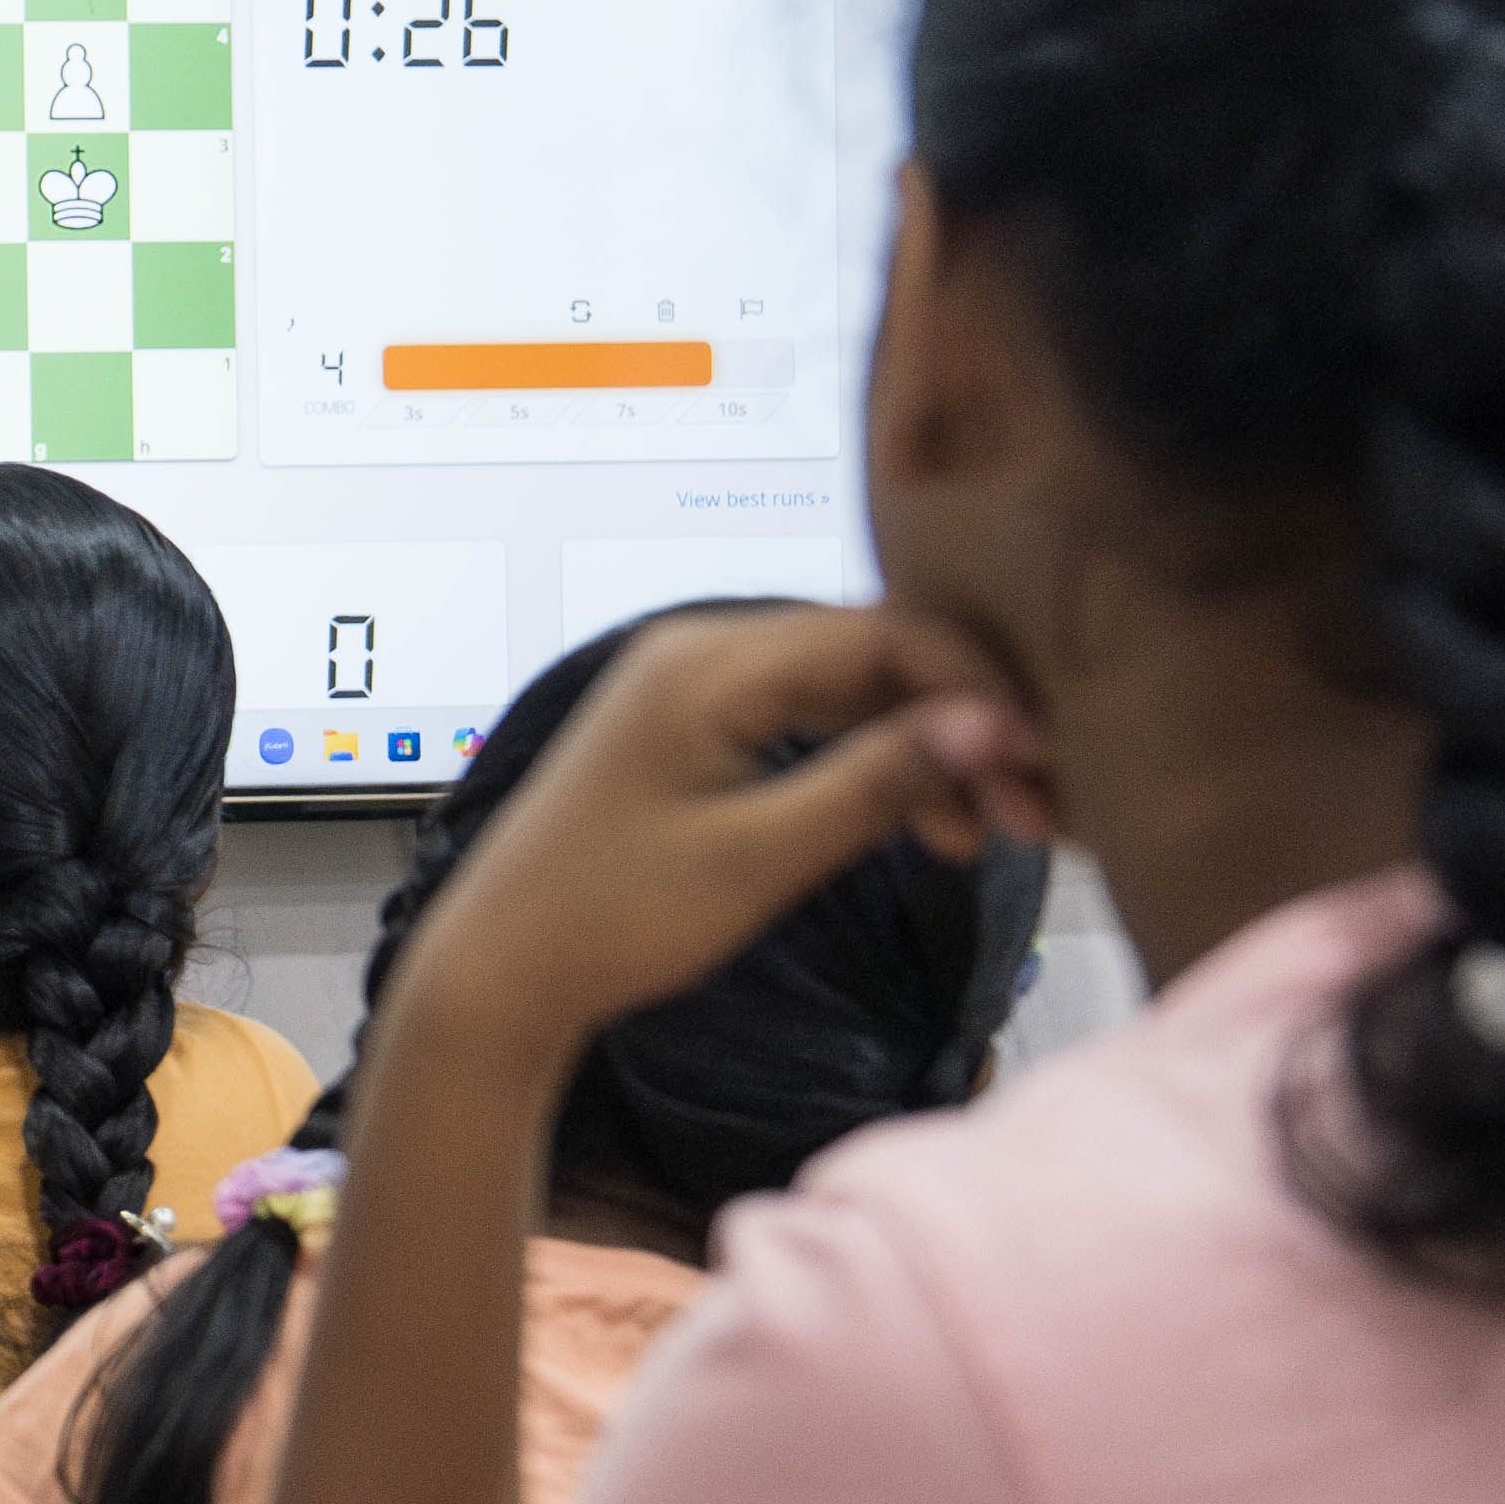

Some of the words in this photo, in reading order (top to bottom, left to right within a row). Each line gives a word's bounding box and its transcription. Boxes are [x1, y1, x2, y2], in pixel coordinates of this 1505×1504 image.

[216, 27, 229, 44] 4
[220, 246, 232, 263] 2
[321, 350, 344, 386] 4
[304, 399, 356, 416] COMBO
[404, 405, 424, 422] 3s
[510, 403, 530, 421] 5s
[616, 402, 636, 419] 7s
[718, 400, 748, 417] 10s
[676, 491, 721, 509] View
[727, 489, 767, 508] best
[772, 491, 816, 507] runs
[327, 614, 376, 699] 0
